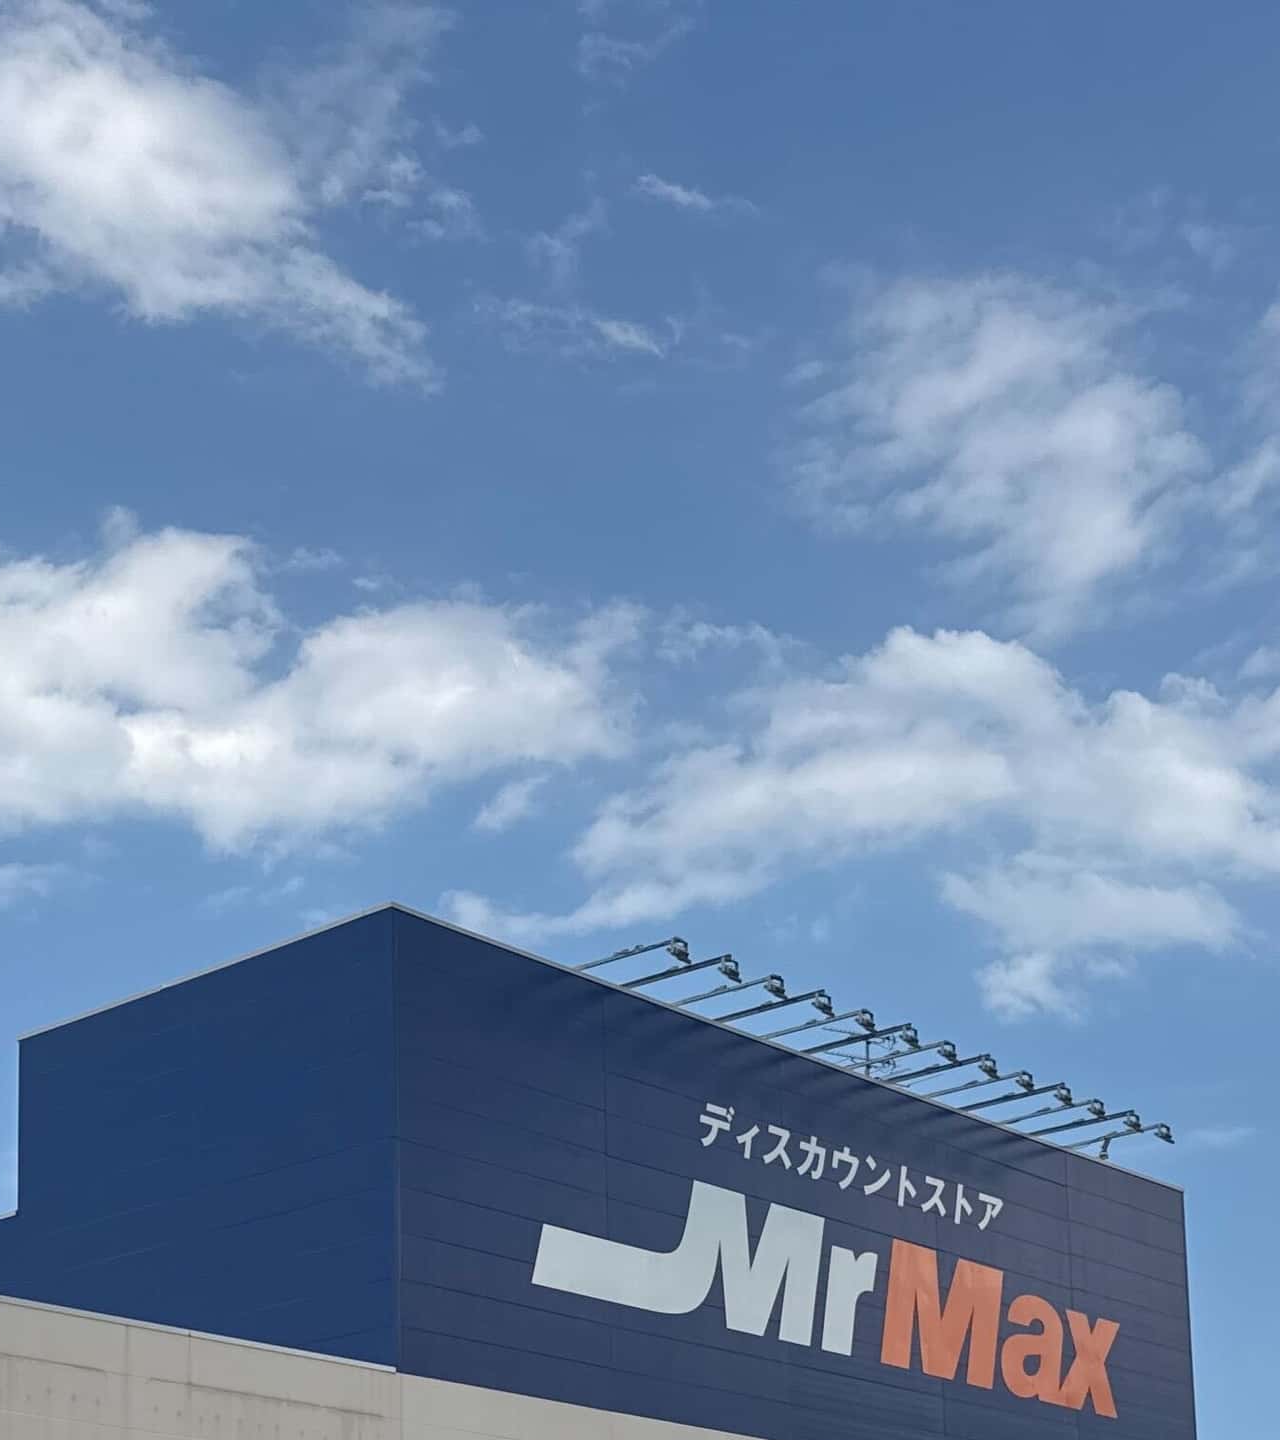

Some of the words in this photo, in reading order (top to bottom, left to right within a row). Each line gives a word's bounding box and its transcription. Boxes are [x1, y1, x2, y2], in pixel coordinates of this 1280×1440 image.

[699, 1103, 1003, 1230] ディスカウントストア
[531, 1179, 1120, 1419] MrMax
